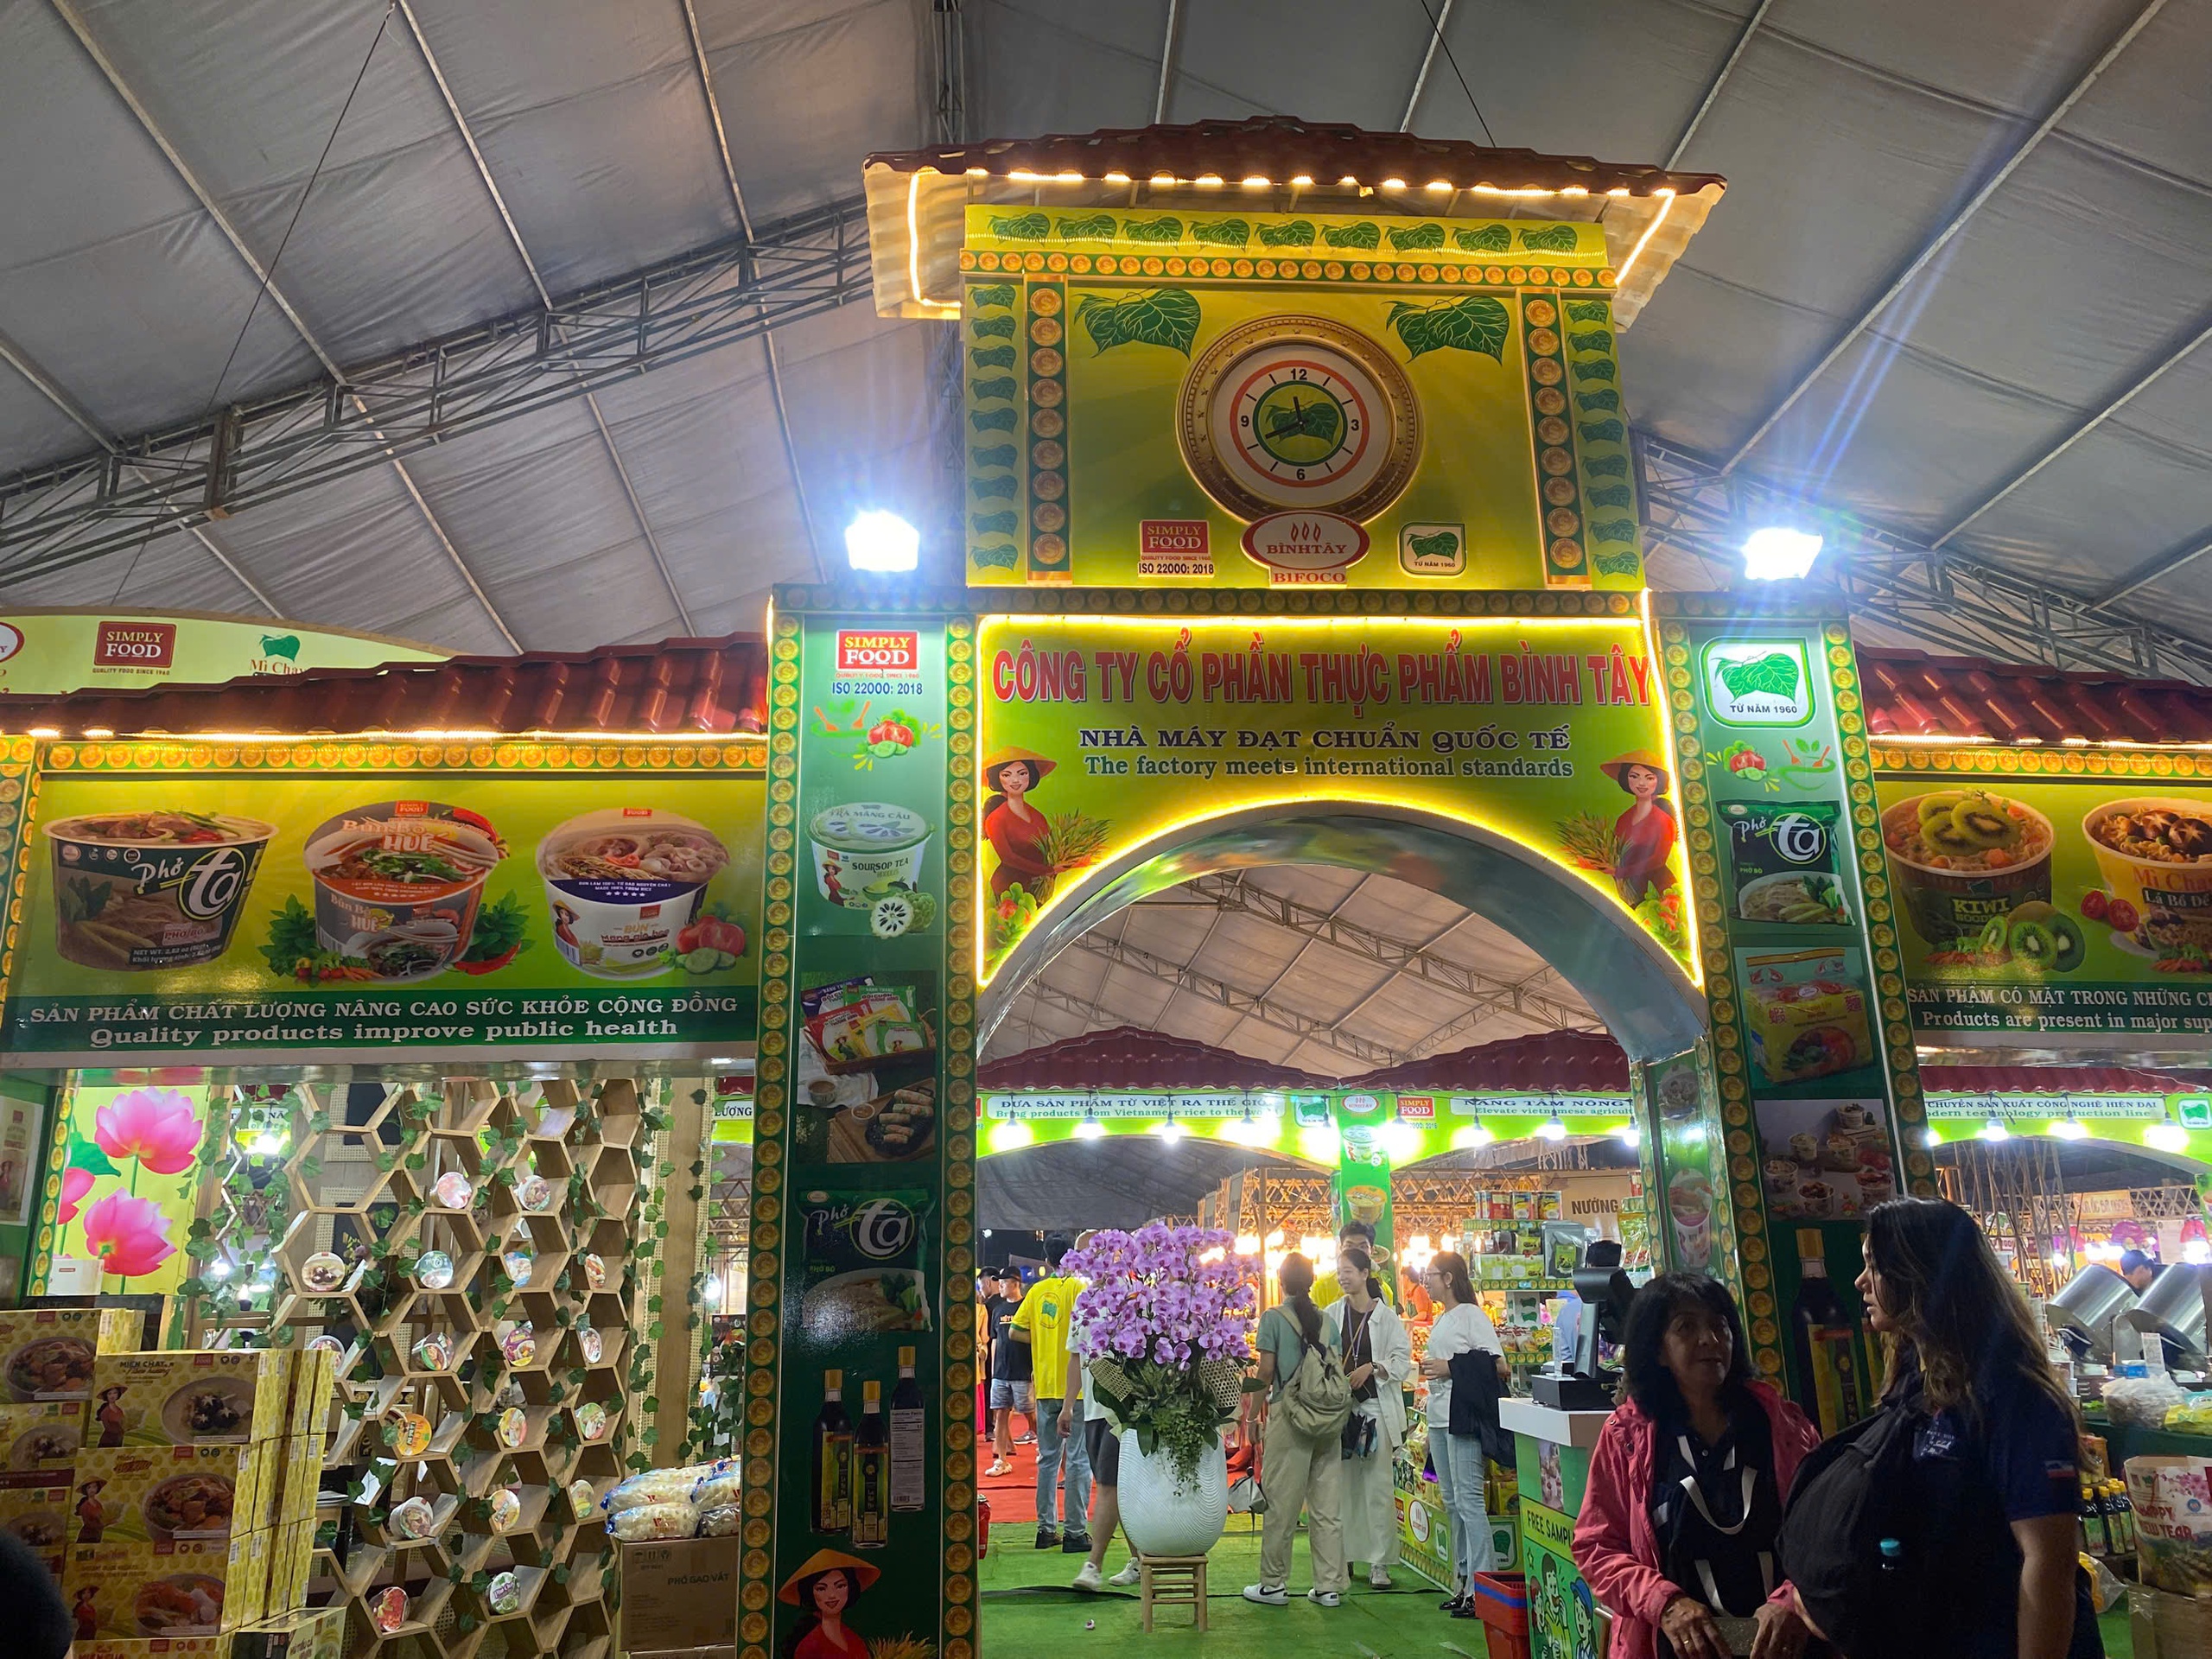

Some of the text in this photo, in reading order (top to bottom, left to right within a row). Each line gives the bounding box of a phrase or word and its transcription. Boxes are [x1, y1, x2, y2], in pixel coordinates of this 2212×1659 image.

[1291, 368, 1307, 380] 12
[1241, 416, 1249, 427] 9
[1351, 420, 1359, 431] 3
[1296, 468, 1306, 480] 6
[1147, 525, 1201, 535] SIMPLY
[1149, 536, 1202, 549] FOOD
[1139, 563, 1214, 574] ISO 22000: 2018
[1274, 571, 1346, 583] BIFOCO
[106, 631, 164, 644] SIMPLY
[845, 637, 910, 648] SIMPLY
[105, 644, 162, 658] FOOD
[845, 650, 910, 664] FOOD
[993, 628, 1652, 718] CÔNG TY CỔ PHẦN THỰC PHẨM BÌNH TÂY
[832, 682, 923, 695] ISO 22000: 2018
[1730, 702, 1798, 714] TỪ NĂM 1960
[1080, 721, 1571, 753] NHÀ MÁY ĐẠT CHUẨN QUỐC TẾ
[1085, 755, 1573, 779] The factory meets international standards
[1733, 813, 1820, 861] Phở ta
[852, 857, 909, 873] SOURSOP TEA
[131, 850, 242, 916] Phở ta
[1952, 898, 2011, 913] KIWI
[1909, 983, 1940, 1003] SẢN
[2000, 986, 2022, 1003] CÓ
[2029, 988, 2065, 1007] MẶT
[2070, 990, 2128, 1005] TRONG
[2133, 988, 2191, 1006] NHỮNG
[30, 991, 737, 1023] SẢN PHẨM CHẤT LƯỢNG NÂNG CAO SỨC KHỎE CỘNG ĐỒNG
[1923, 1011, 1999, 1027] Products
[2005, 1014, 2031, 1027] are
[2038, 1013, 2101, 1031] present
[2107, 1013, 2125, 1027] in
[2131, 1014, 2177, 1033] major
[90, 1020, 677, 1048] Quality products improve public health
[1001, 1098, 1031, 1108] ĐƯA
[1037, 1098, 1065, 1107] SẢN
[1031, 1109, 1080, 1118] products
[1926, 1109, 1961, 1117] odern
[1572, 1197, 1618, 1215] NƯỚNG
[810, 1198, 908, 1255] Phở ta
[1527, 1510, 1573, 1547] FREE SAMPL
[2159, 1523, 2196, 1540] YEAR
